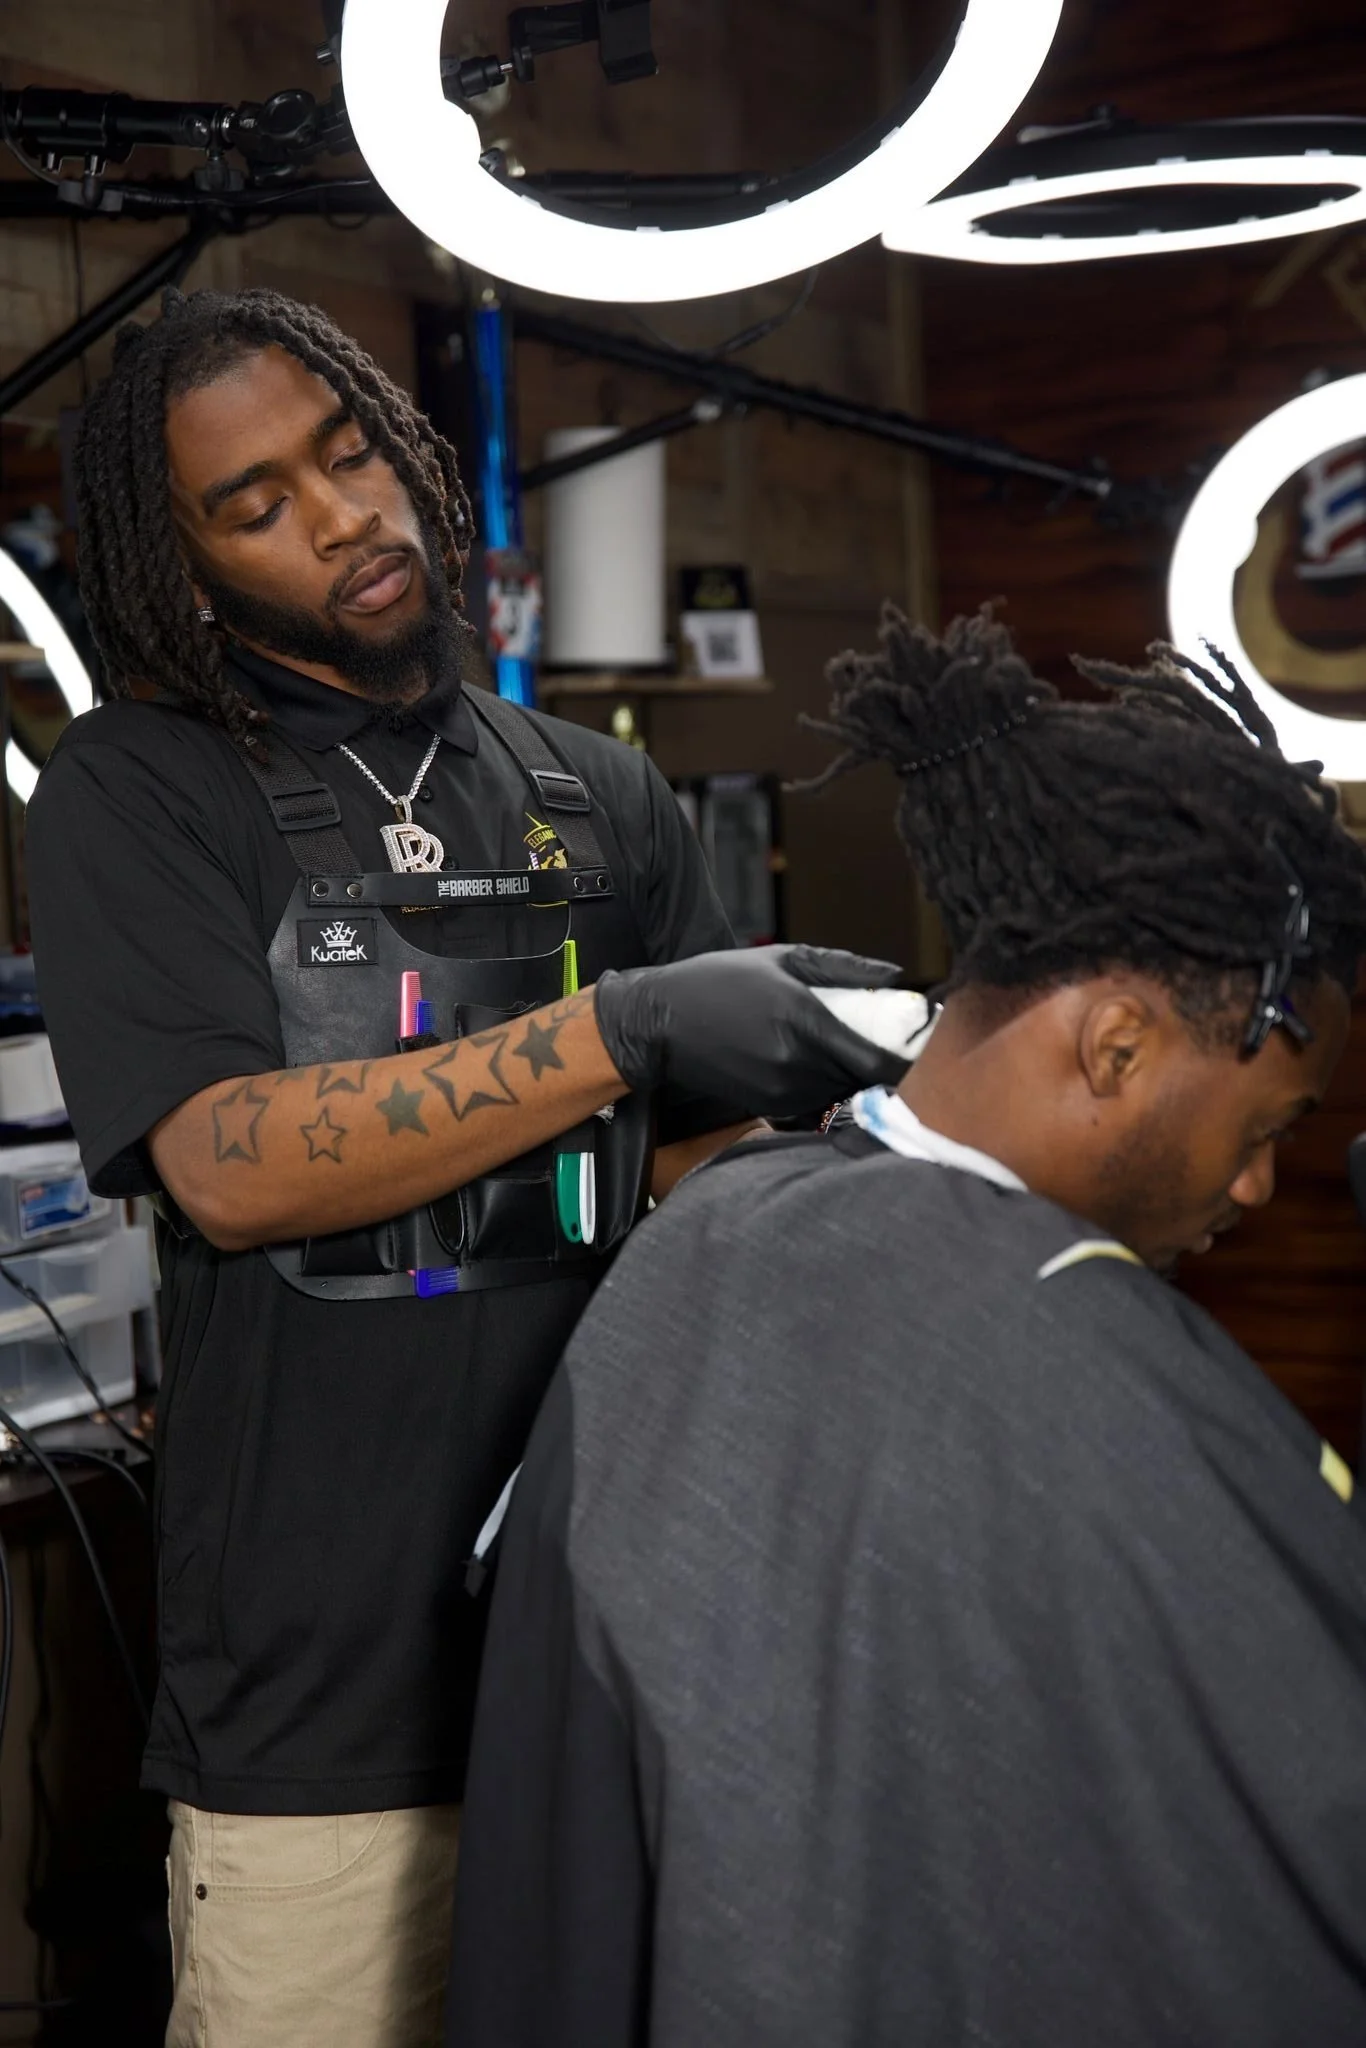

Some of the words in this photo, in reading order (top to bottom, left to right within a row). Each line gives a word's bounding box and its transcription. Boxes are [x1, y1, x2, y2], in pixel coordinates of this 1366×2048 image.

[437, 880, 450, 897] THE
[449, 879, 494, 897] BARBER
[496, 876, 530, 895] SHIELD
